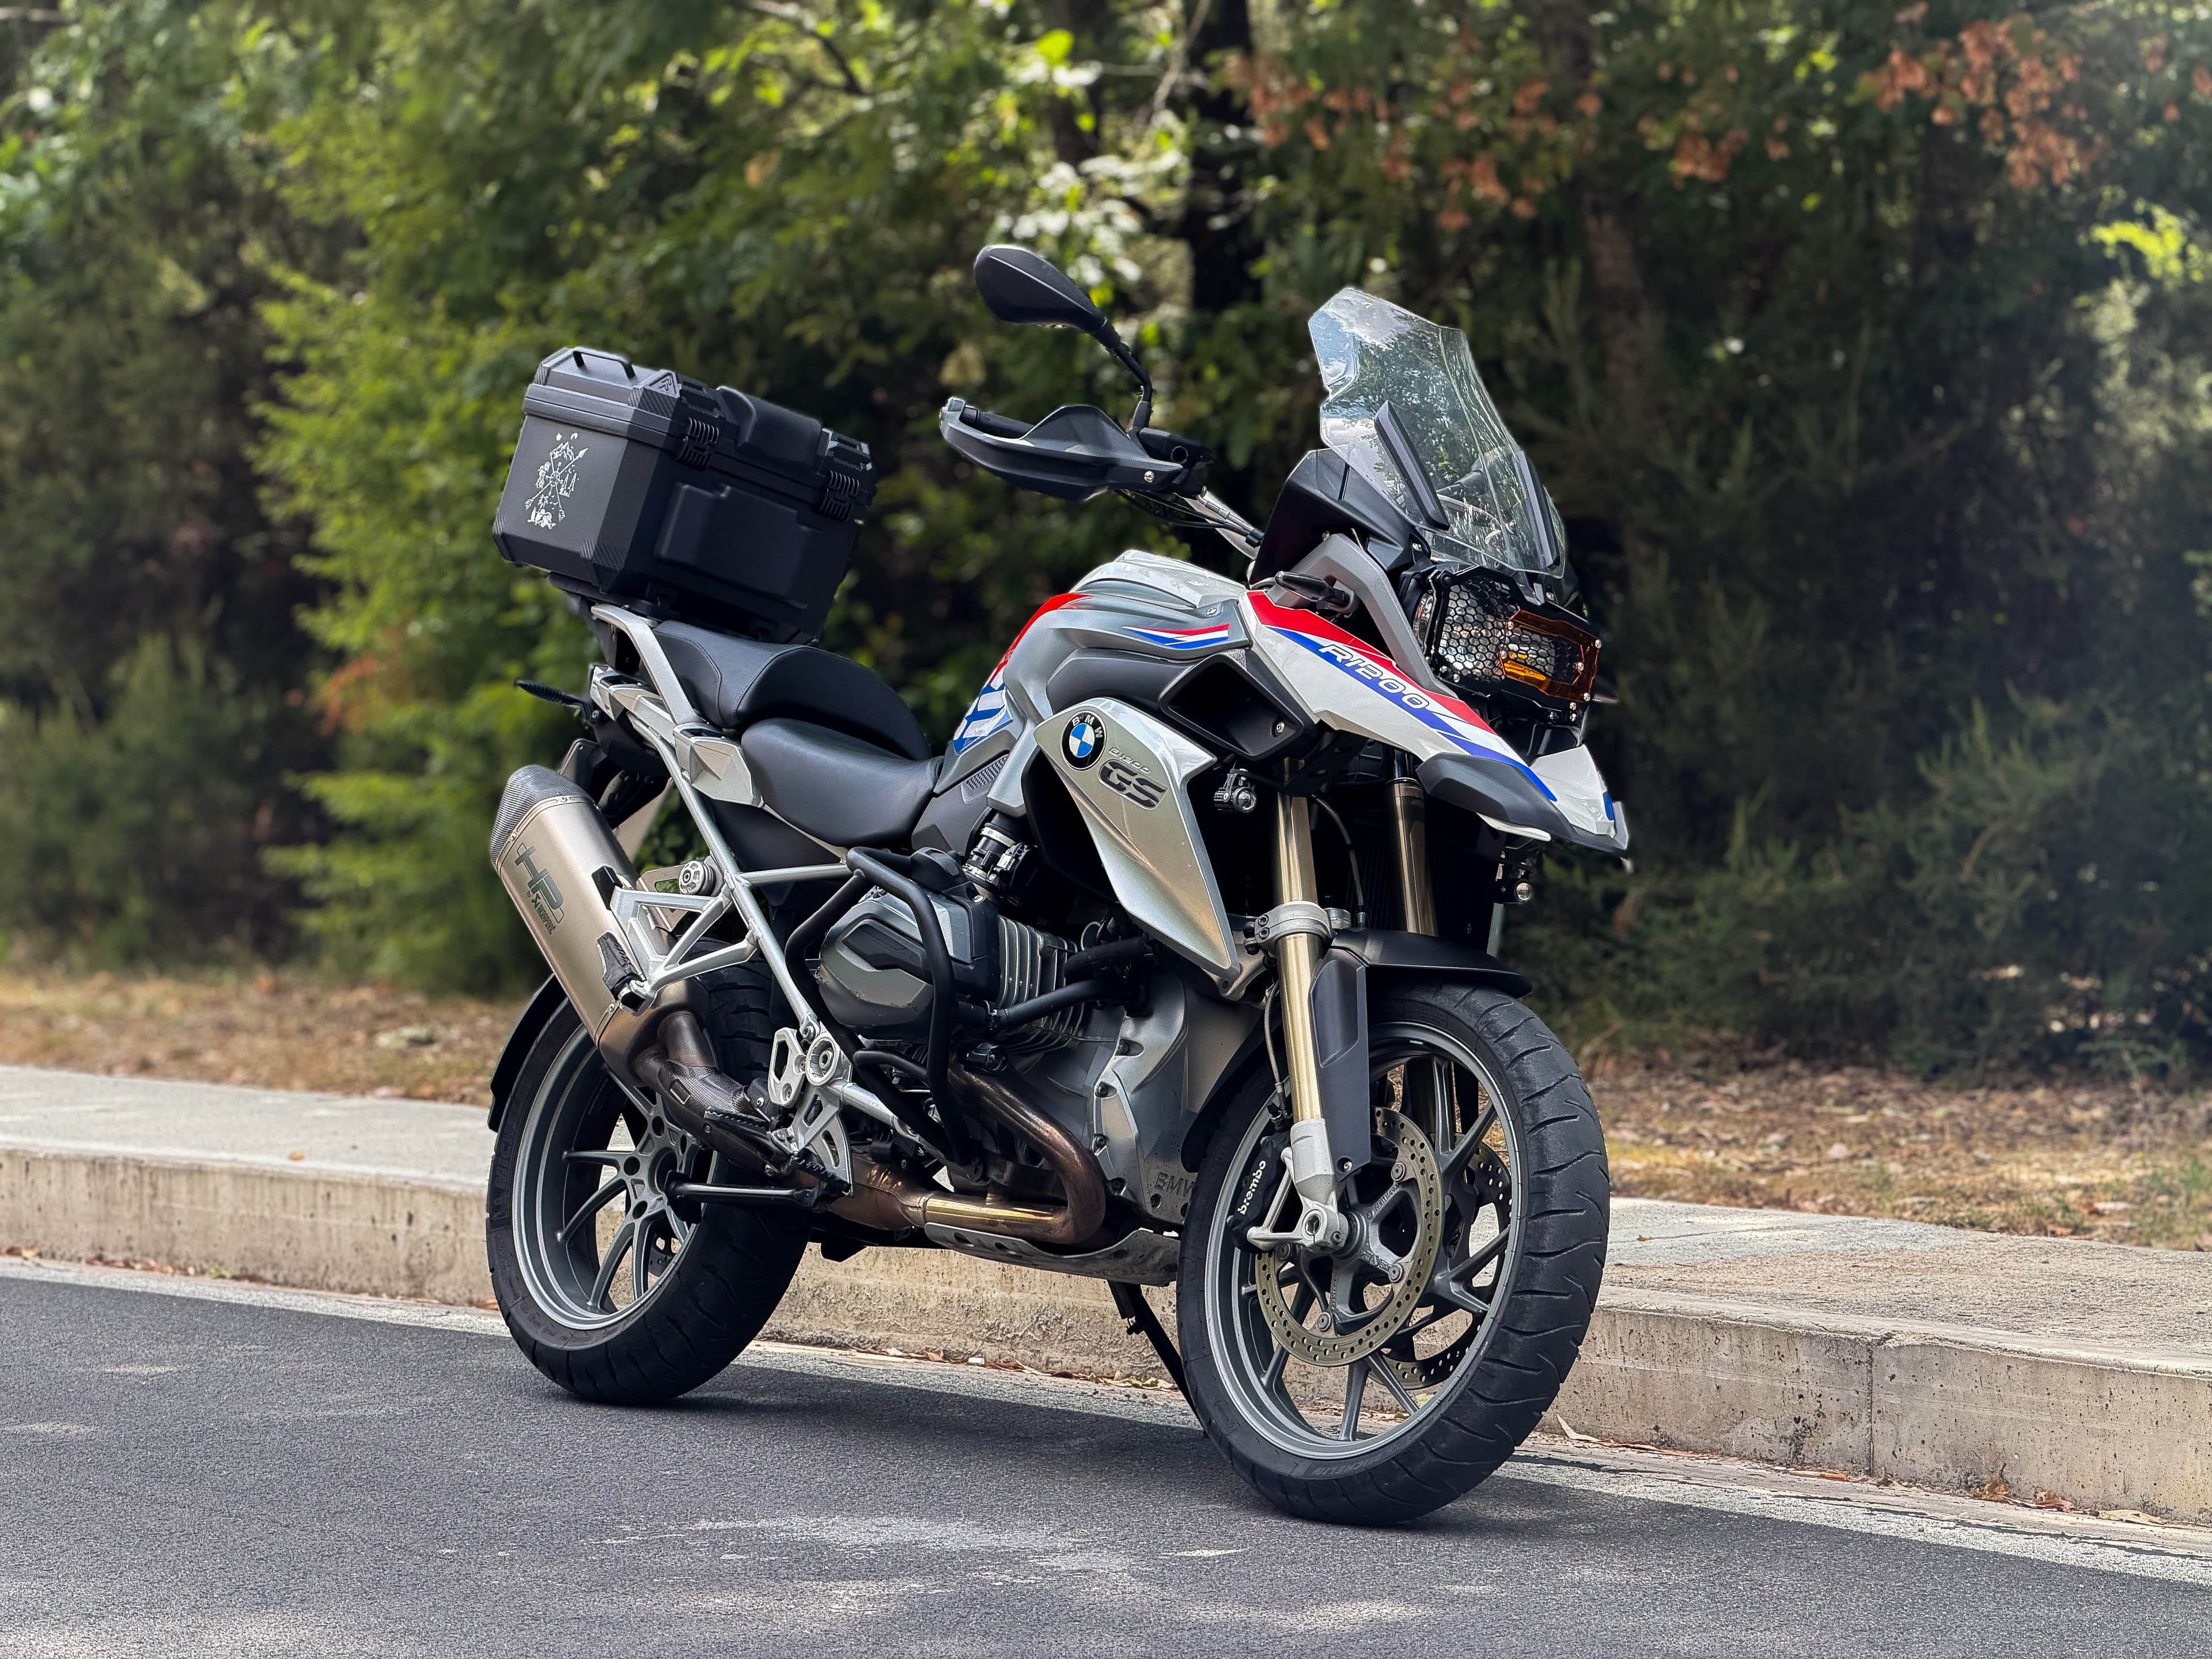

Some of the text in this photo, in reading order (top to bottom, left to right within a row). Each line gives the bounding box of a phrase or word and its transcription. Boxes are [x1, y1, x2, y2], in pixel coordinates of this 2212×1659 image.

[1318, 644, 1430, 710] R1200
[1071, 714, 1103, 738] BMW
[1099, 760, 1167, 808] GS
[514, 846, 564, 910] HP
[1237, 1160, 1266, 1215] brembo
